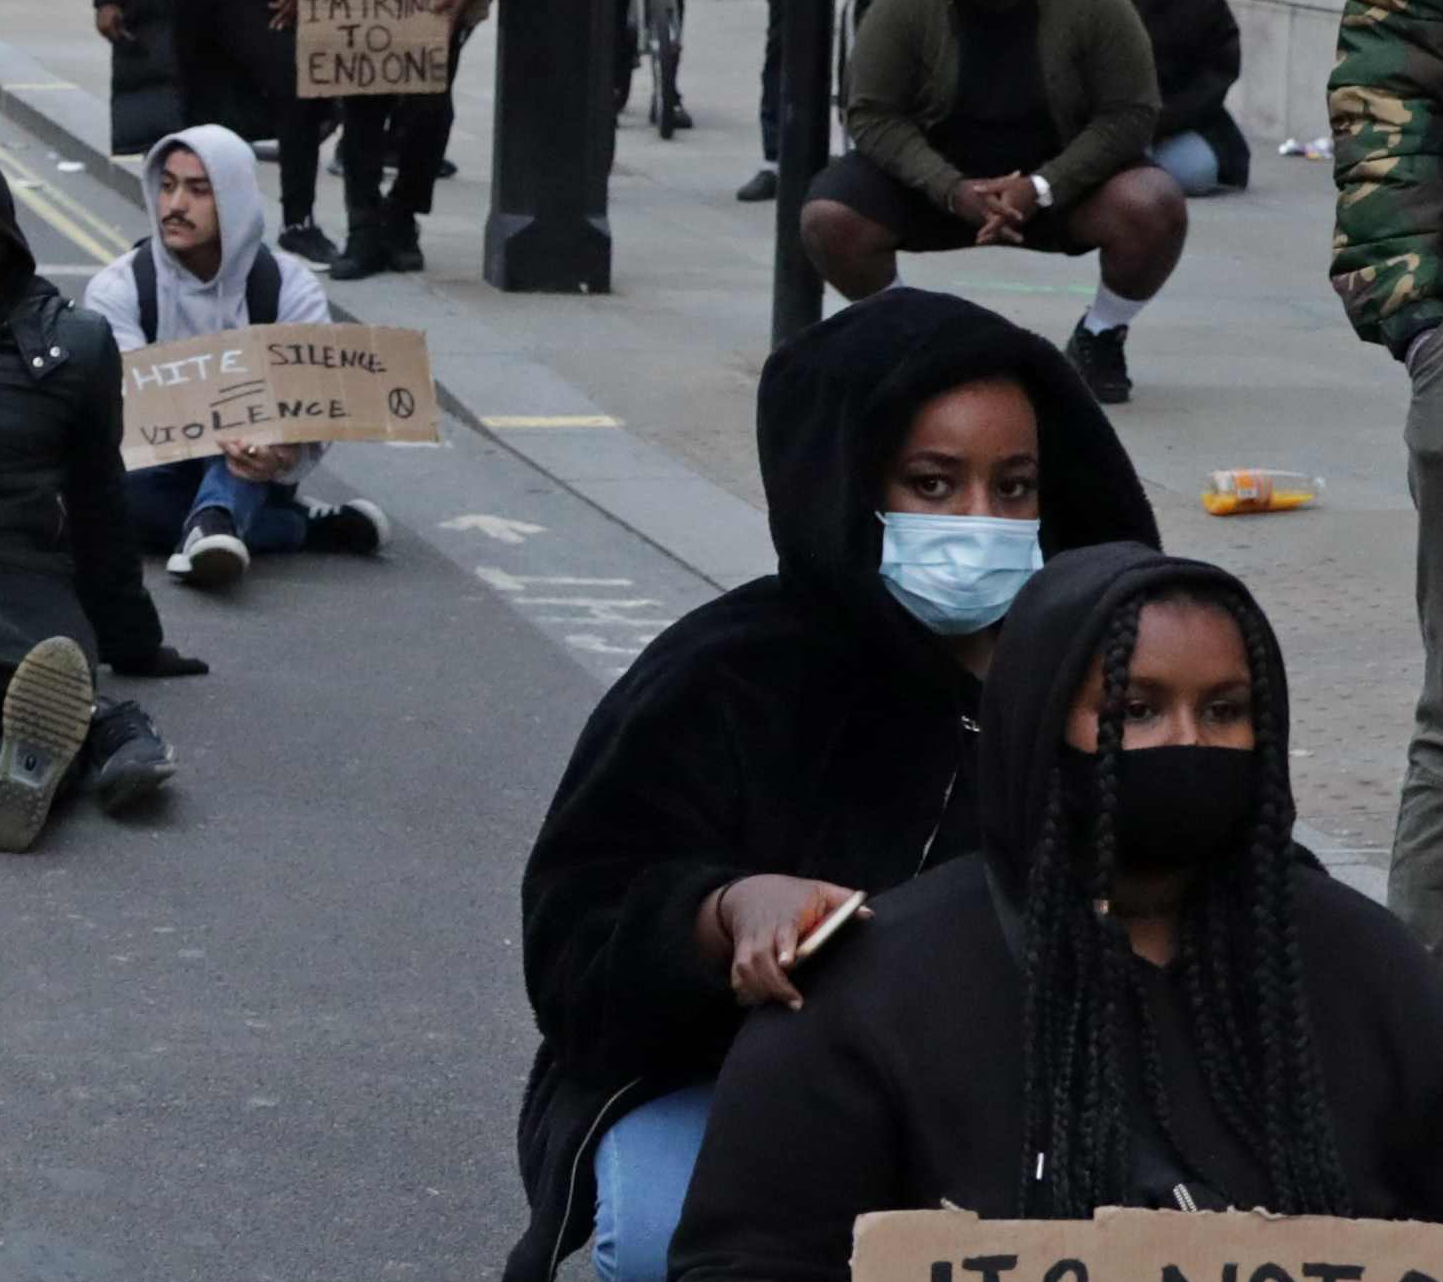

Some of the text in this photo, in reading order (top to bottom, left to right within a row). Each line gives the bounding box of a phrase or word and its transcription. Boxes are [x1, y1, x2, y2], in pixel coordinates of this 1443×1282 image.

[338, 24, 392, 52] TO
[308, 46, 447, 87] END ONE
[122, 349, 248, 396] HITE
[141, 398, 348, 446] VIOLENCE
